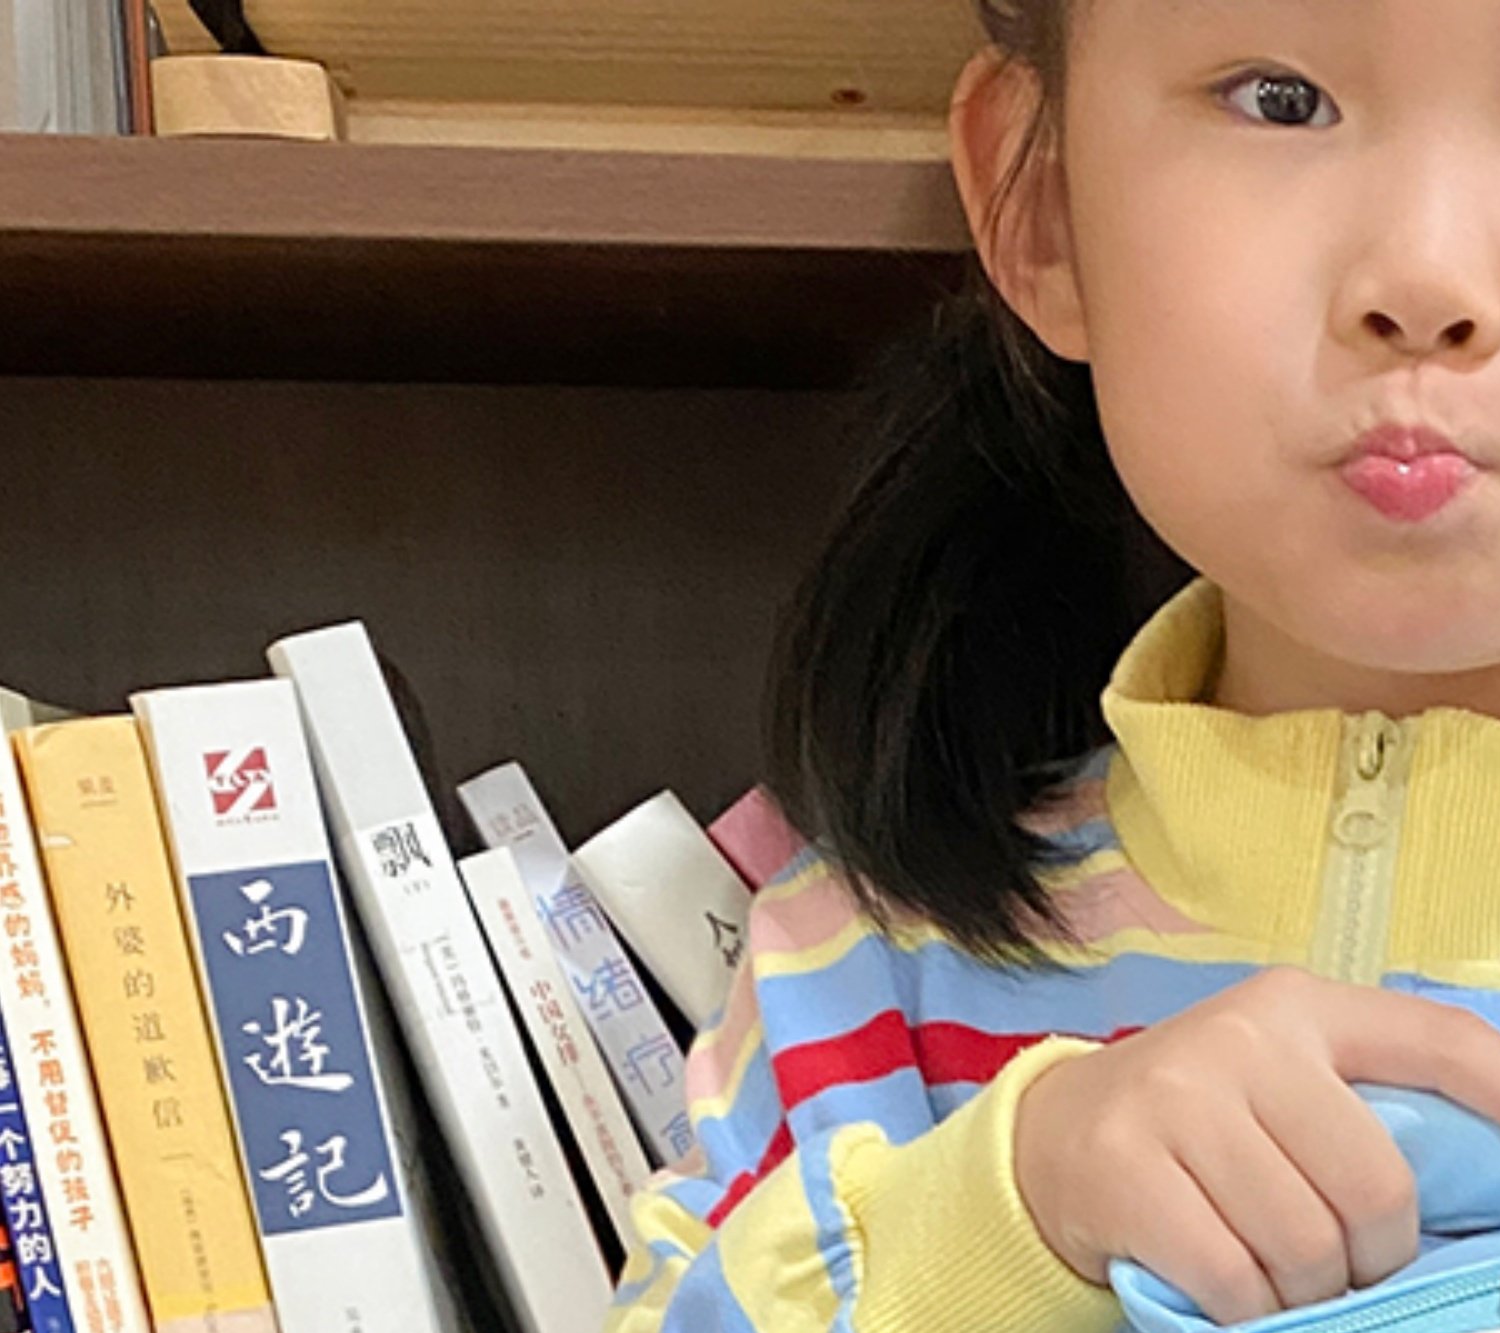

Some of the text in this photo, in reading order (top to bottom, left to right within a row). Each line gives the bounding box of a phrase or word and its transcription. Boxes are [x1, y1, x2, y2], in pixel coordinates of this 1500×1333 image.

[370, 820, 432, 878] 飘
[104, 880, 184, 1129] 外婆的道歉信
[222, 878, 389, 1217] 西遊記
[29, 1030, 95, 1232] 不用督促的孩子
